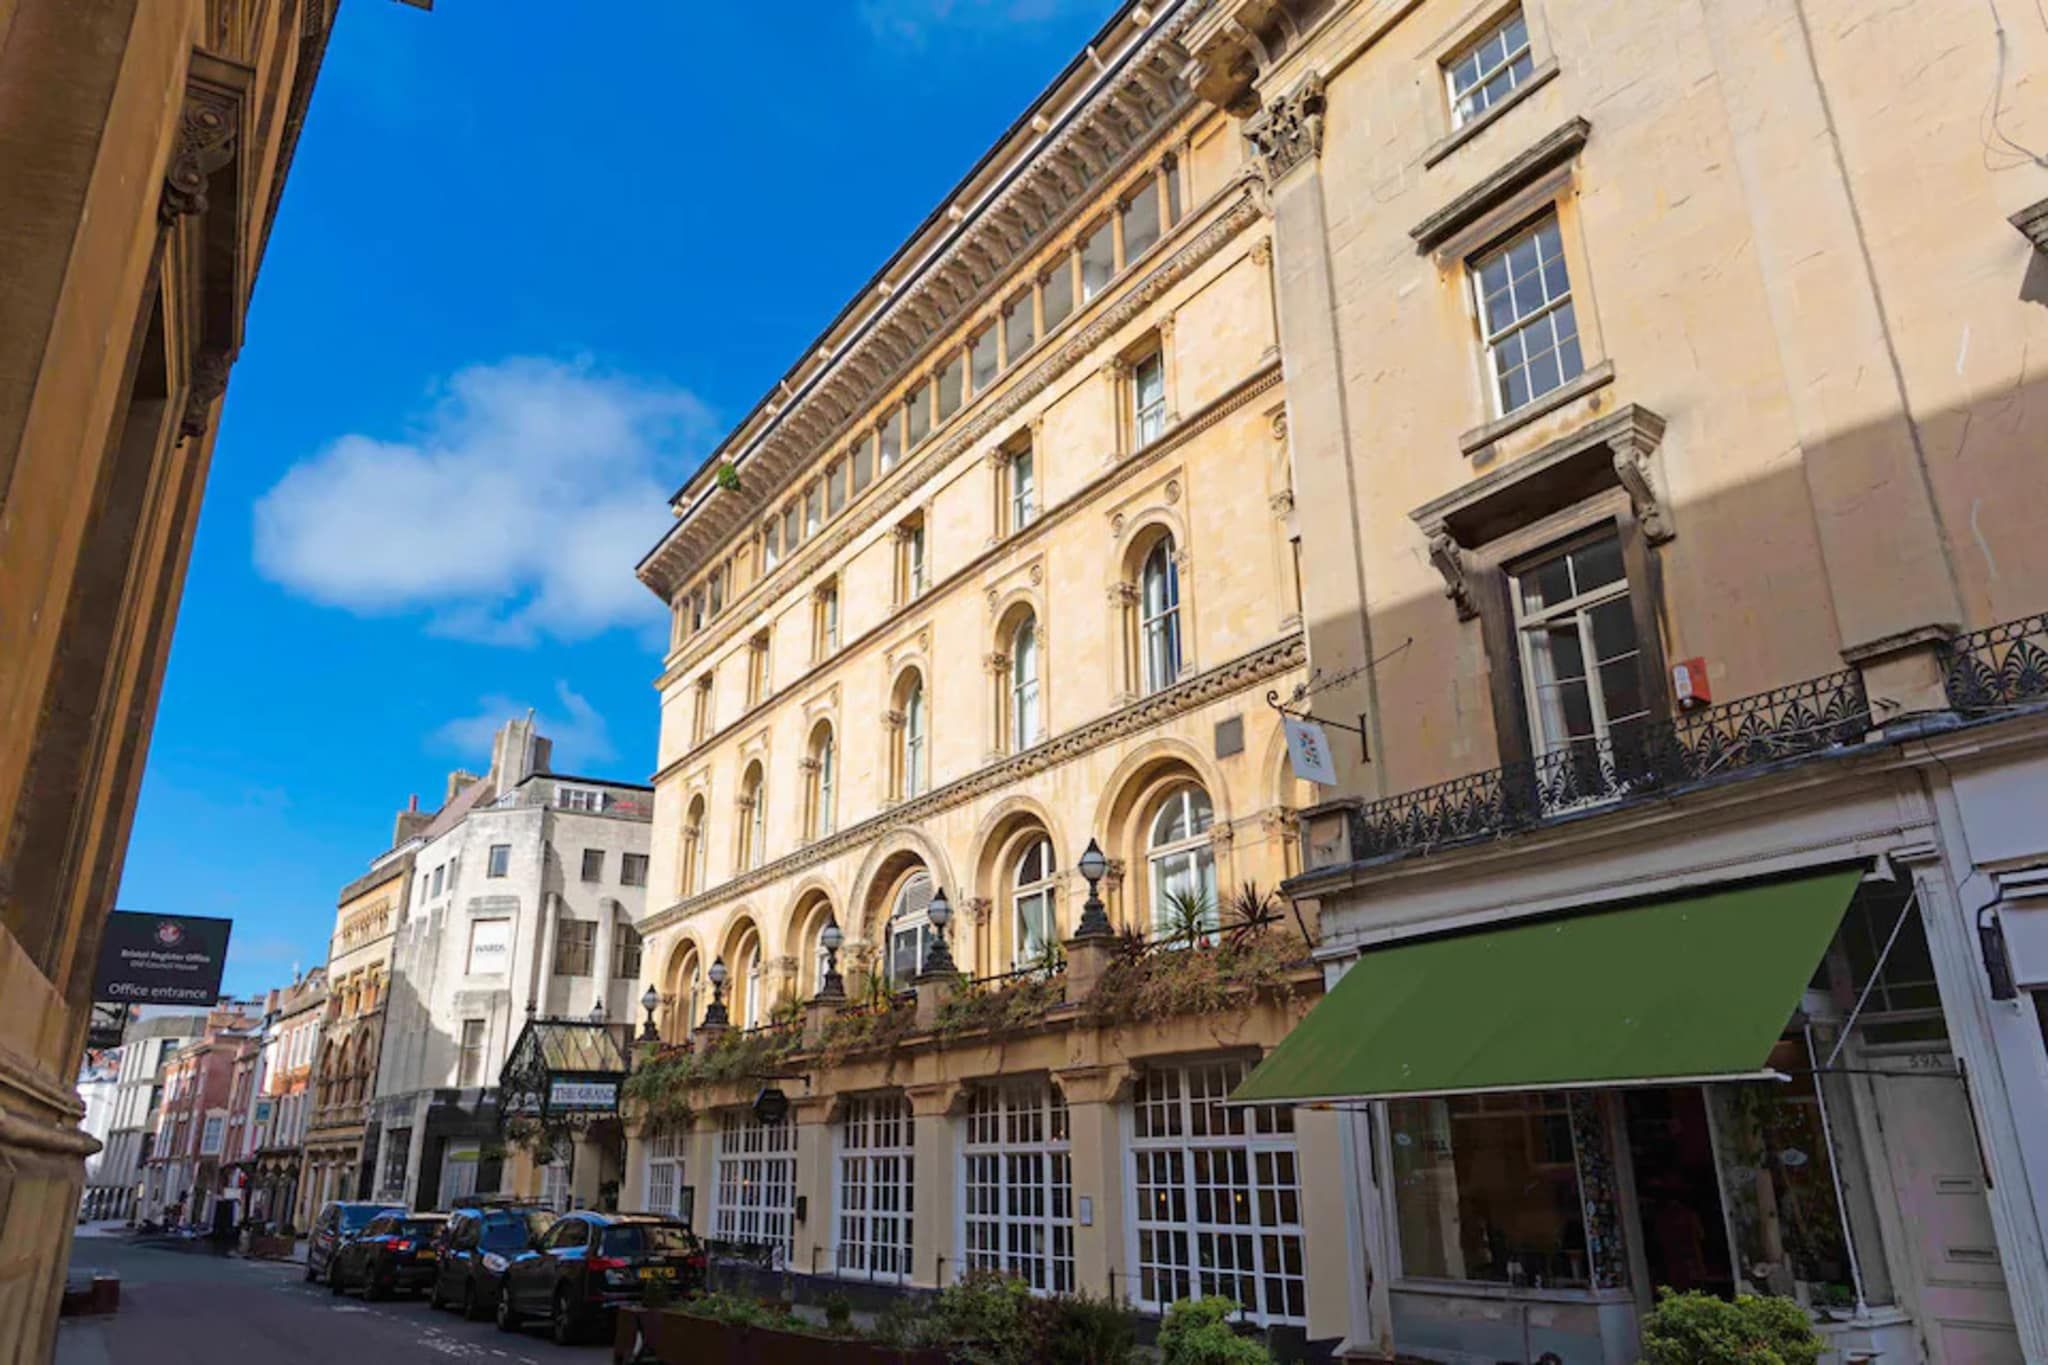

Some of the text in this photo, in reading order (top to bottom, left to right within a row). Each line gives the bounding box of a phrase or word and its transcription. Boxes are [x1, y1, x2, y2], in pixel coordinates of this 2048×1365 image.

[185, 953, 211, 963] Office
[109, 983, 208, 999] Office entrance
[554, 1087, 615, 1100] THE GRAND
